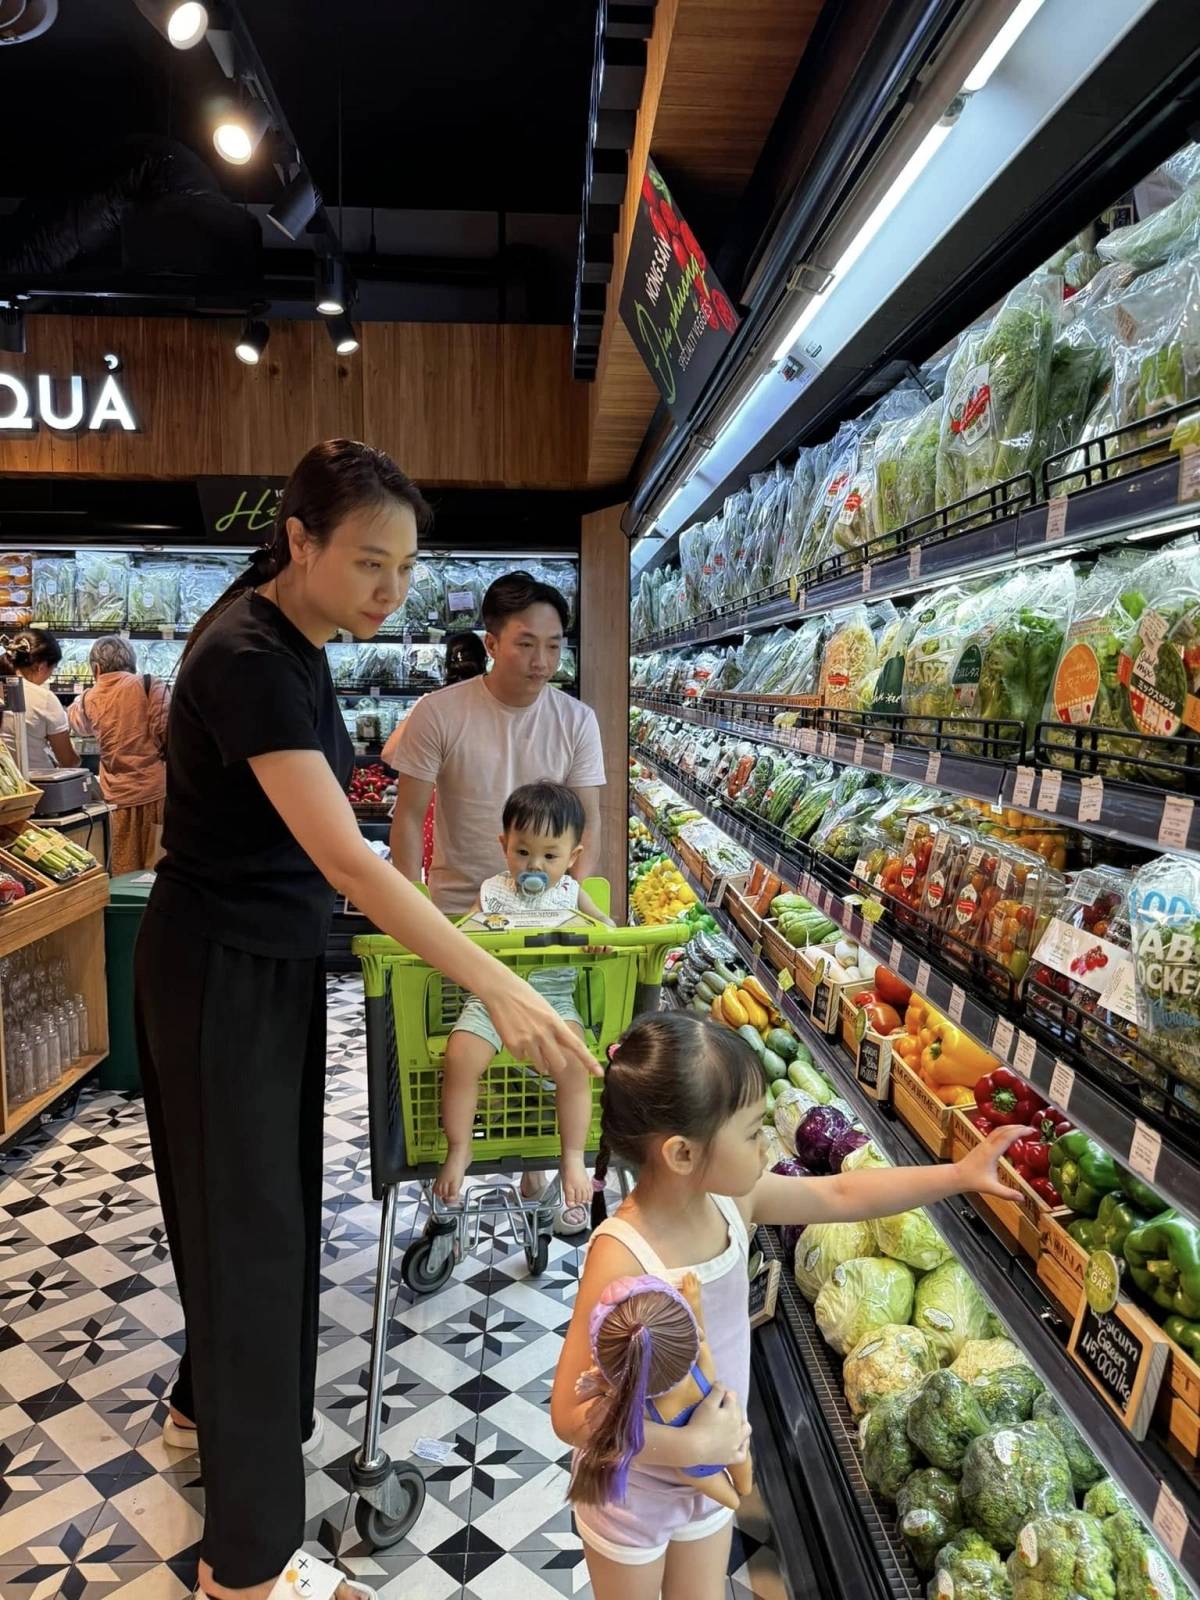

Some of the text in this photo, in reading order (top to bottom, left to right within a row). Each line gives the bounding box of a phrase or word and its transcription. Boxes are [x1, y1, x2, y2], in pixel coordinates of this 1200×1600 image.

[645, 234, 672, 307] NÔNG SẢN
[679, 298, 712, 371] SPECIALTY VEGGIES
[0, 353, 136, 430] QUẢ
[1136, 960, 1200, 996] OCKE
[1091, 1309, 1138, 1361] psicum
